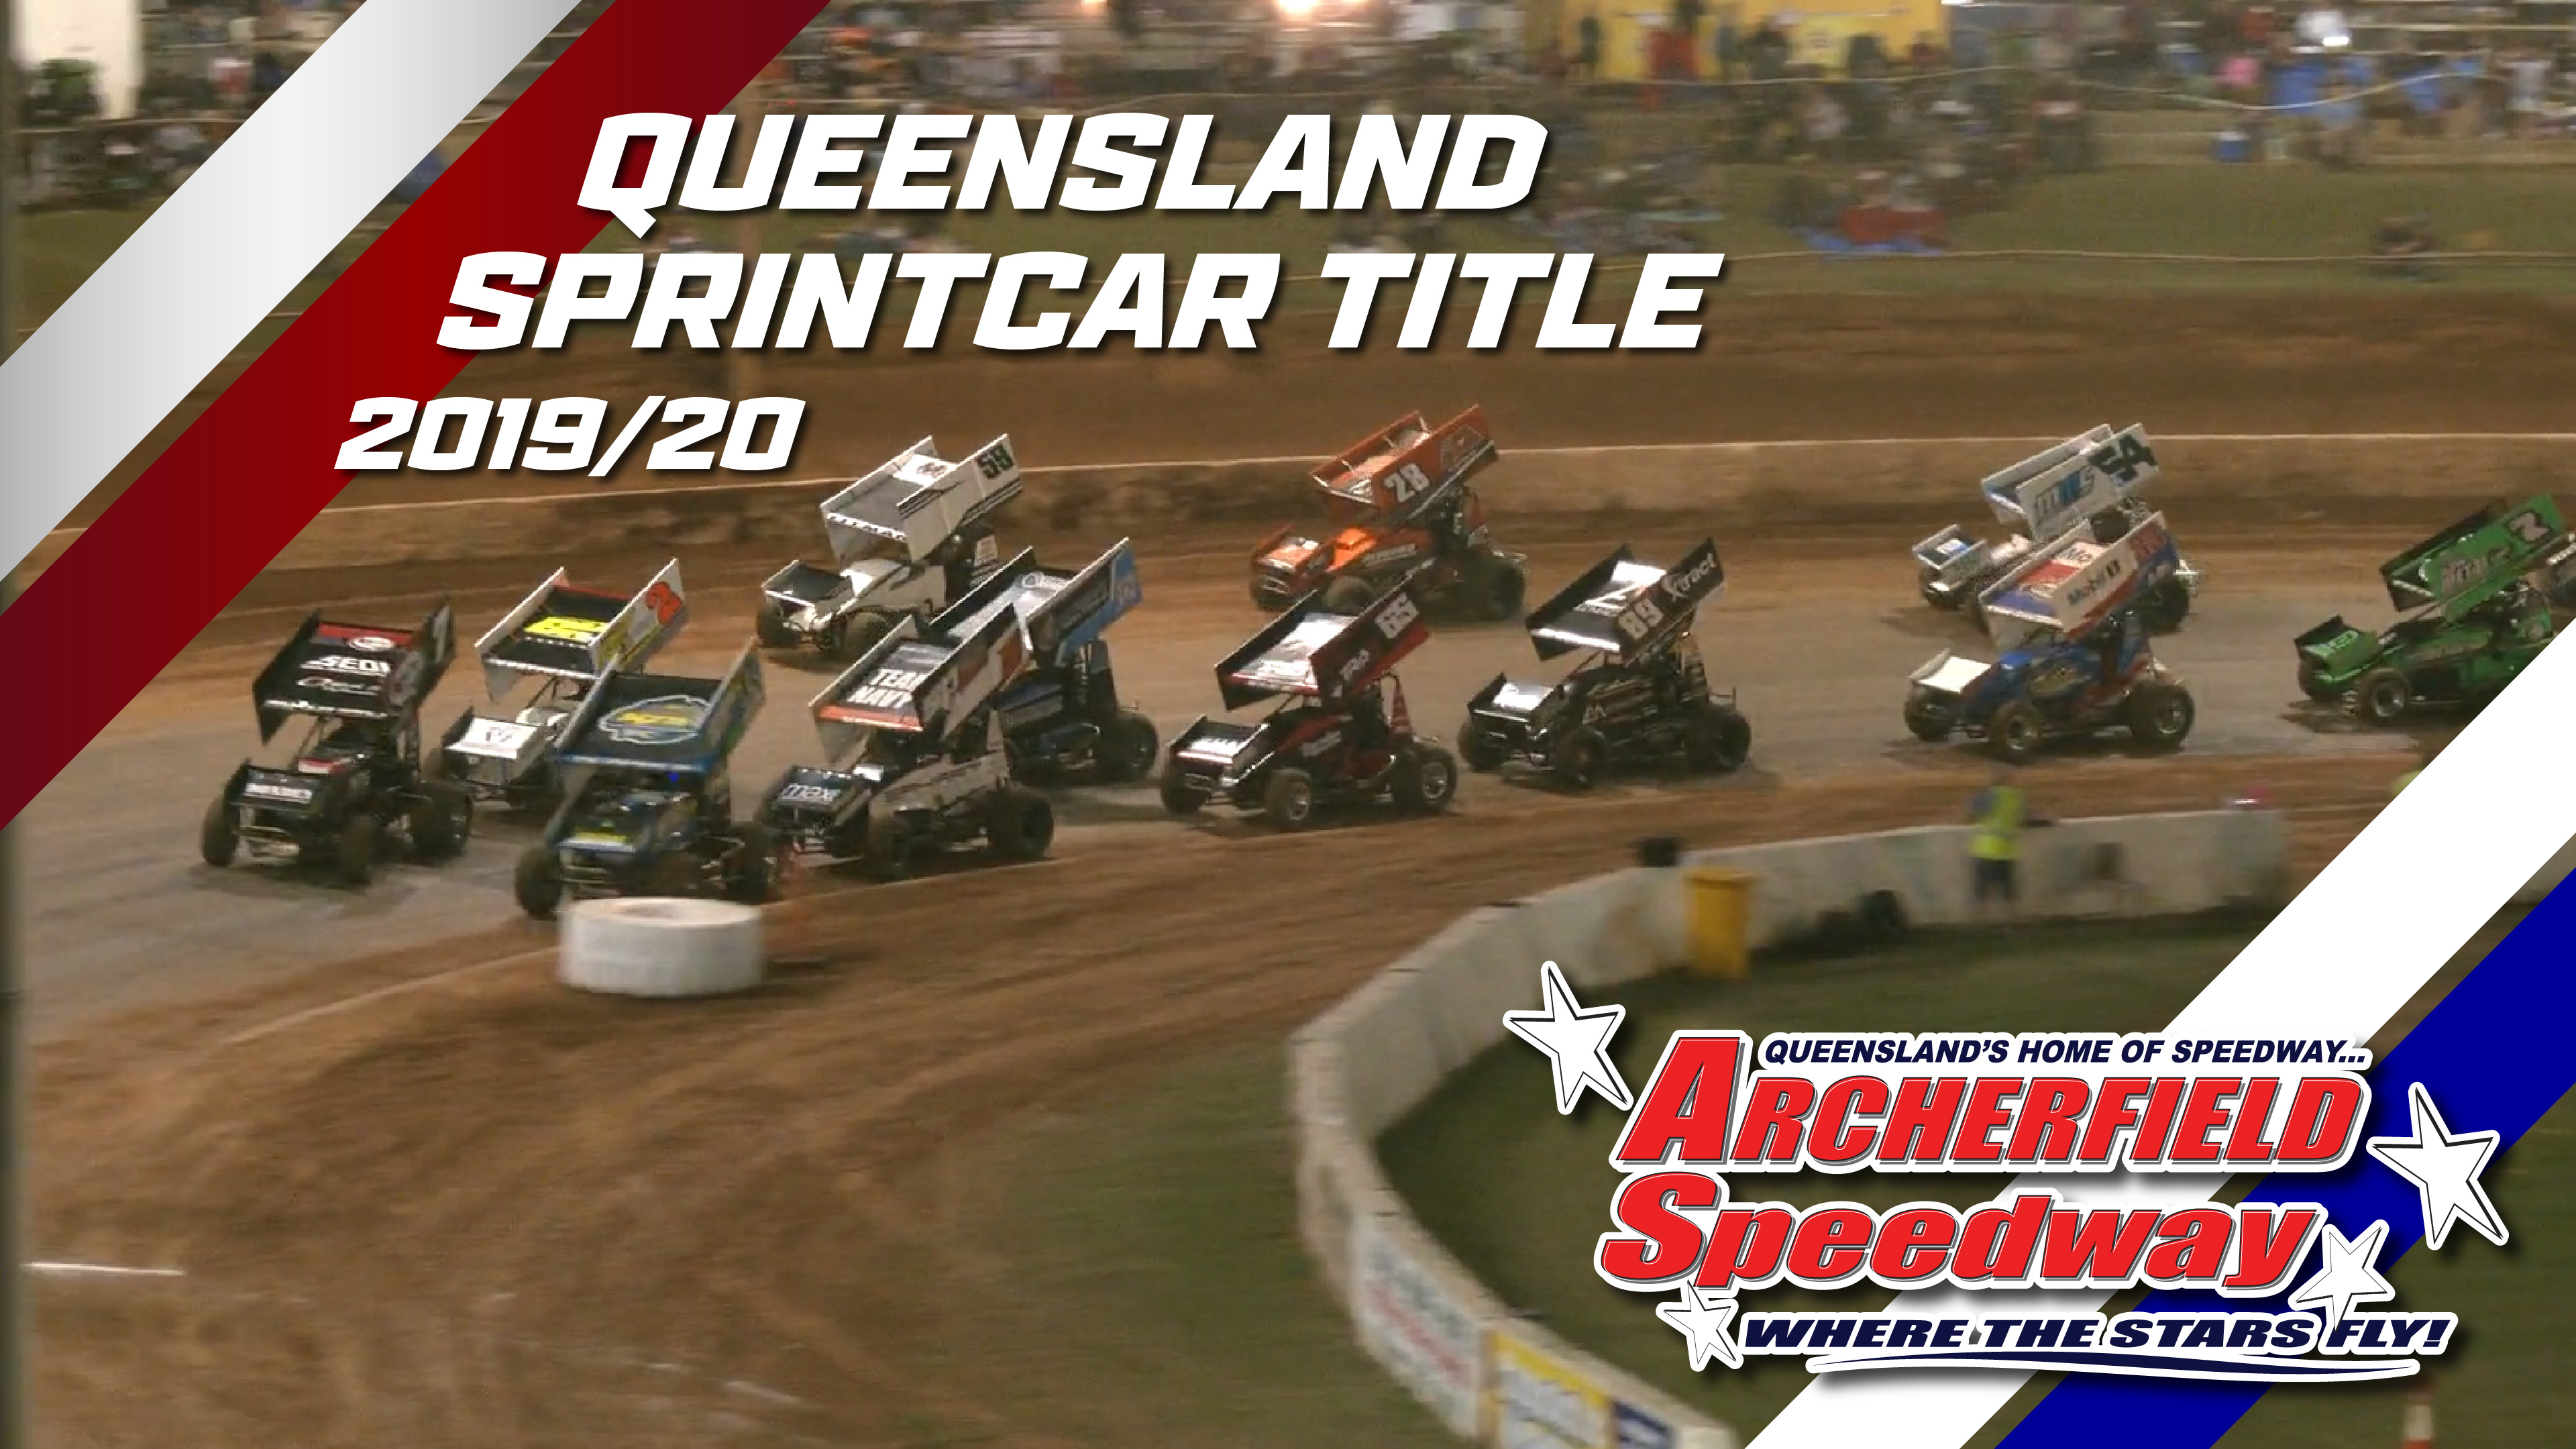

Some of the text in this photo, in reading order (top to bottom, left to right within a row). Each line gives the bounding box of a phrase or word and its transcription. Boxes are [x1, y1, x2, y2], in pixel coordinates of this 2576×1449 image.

[1383, 463, 1430, 503] 28
[2508, 512, 2551, 541] 2
[1617, 598, 1665, 640] 89
[847, 686, 912, 708] NAVY
